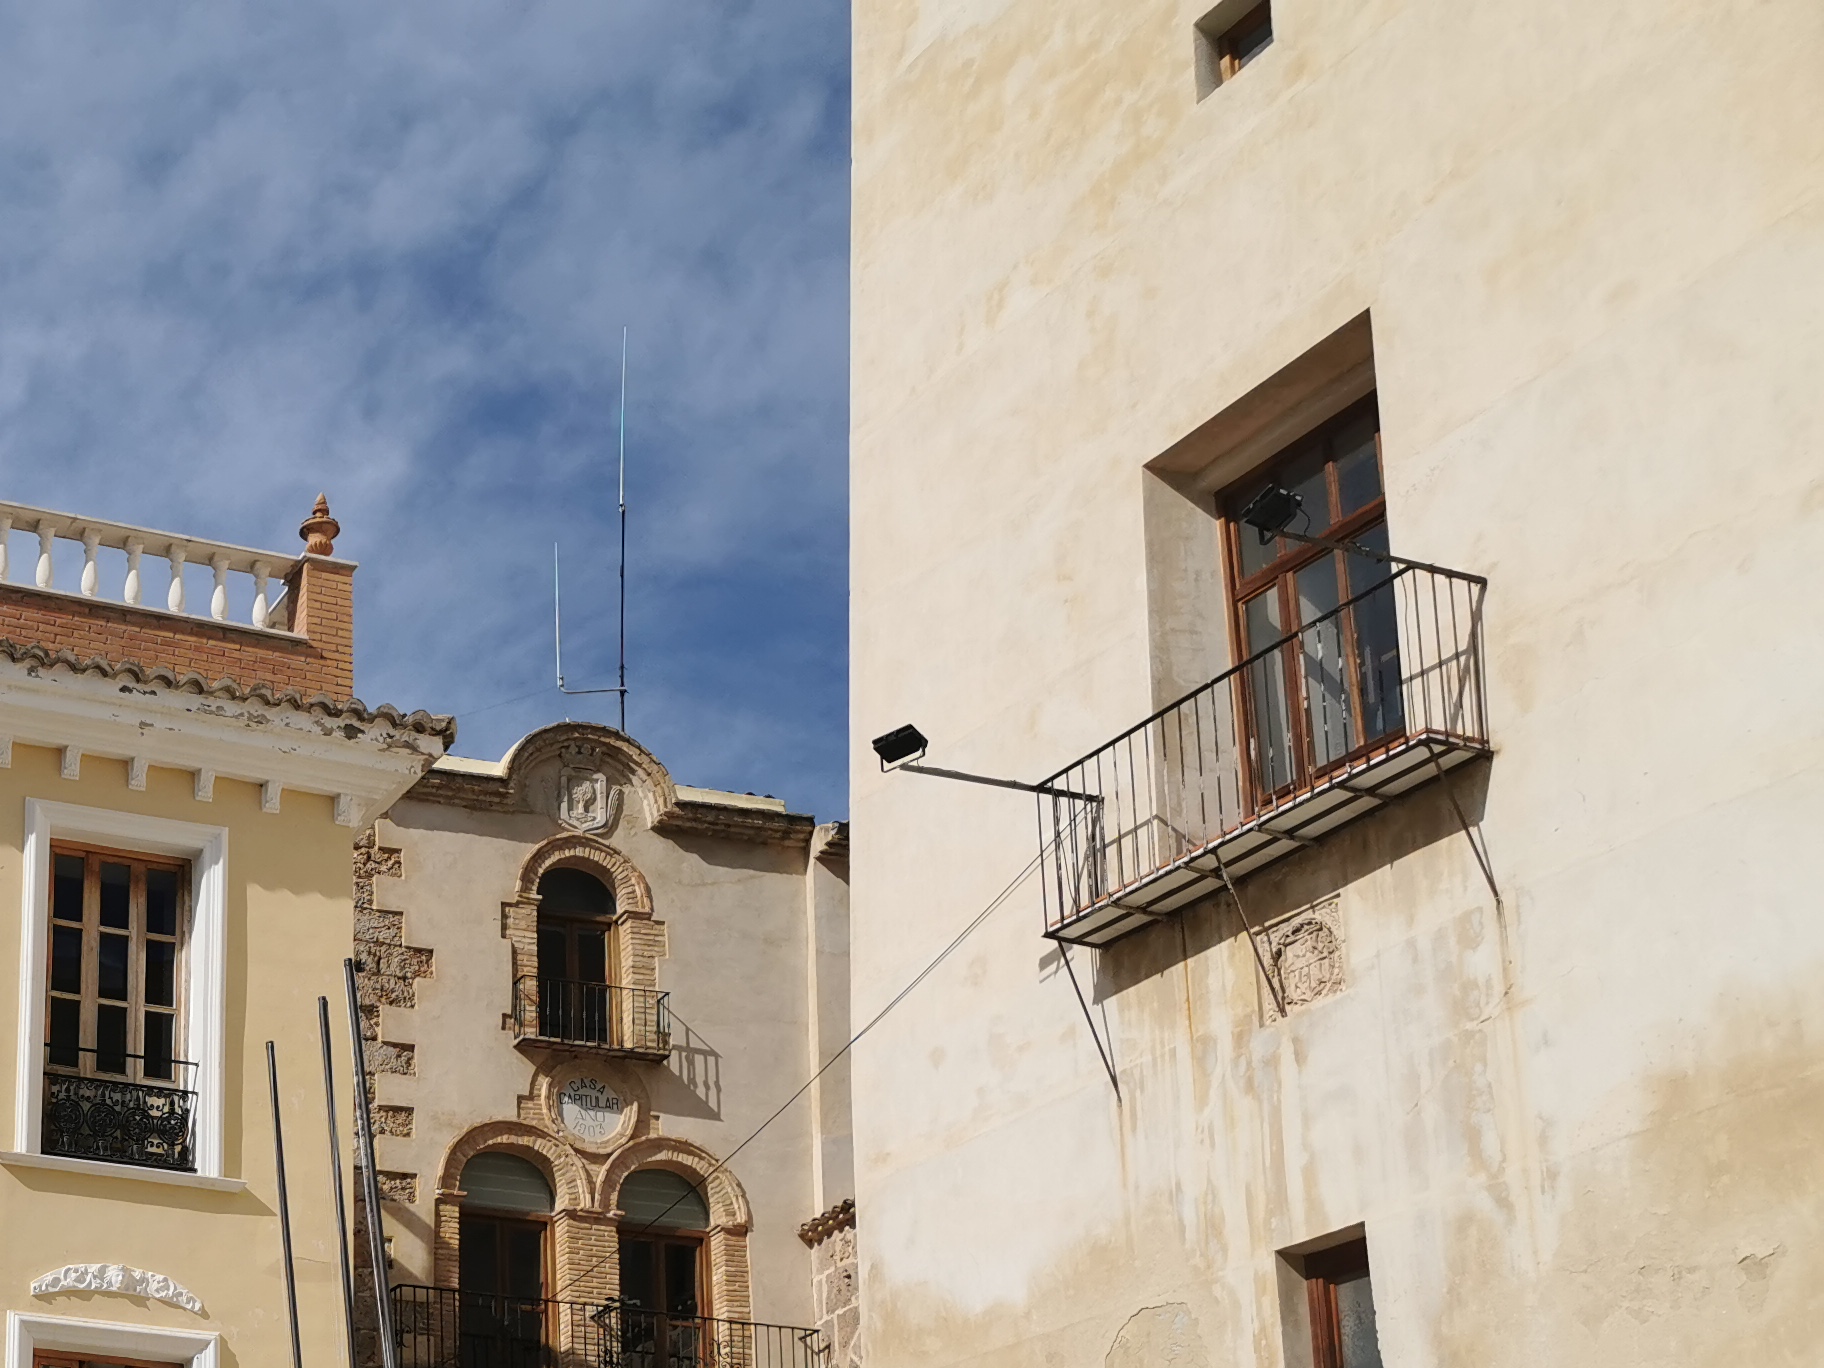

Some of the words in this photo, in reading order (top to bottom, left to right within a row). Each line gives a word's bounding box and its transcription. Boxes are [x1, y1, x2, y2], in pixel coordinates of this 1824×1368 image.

[569, 1078, 606, 1095] CASA
[559, 1092, 619, 1110] CAPITULAR
[574, 1108, 605, 1123] AÑO
[573, 1121, 605, 1137] 1903
